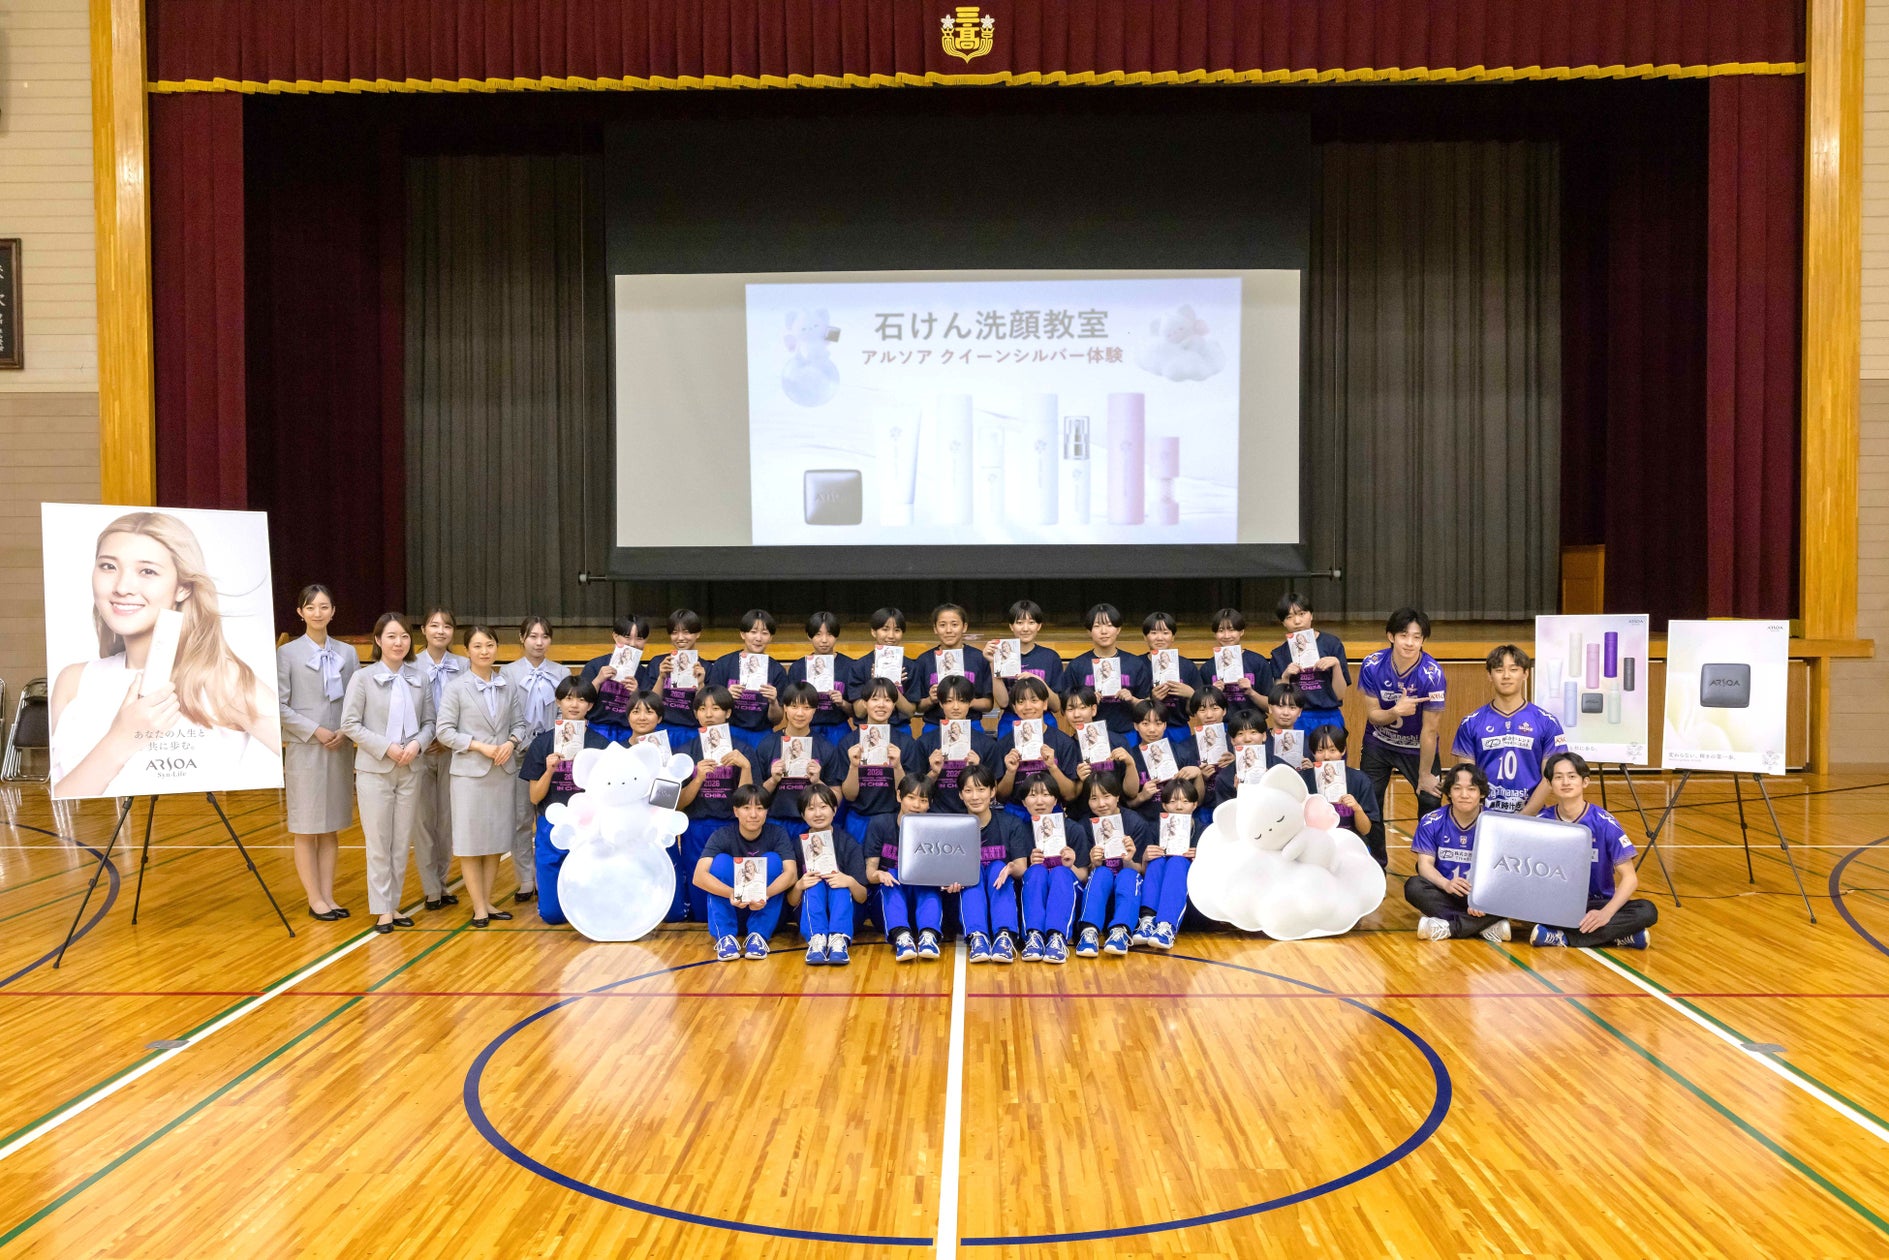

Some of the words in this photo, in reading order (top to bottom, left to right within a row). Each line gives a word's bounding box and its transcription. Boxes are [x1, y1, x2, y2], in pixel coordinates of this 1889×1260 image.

[874, 309, 1109, 341] 石けん洗顔教室
[862, 350, 932, 364] アルソア
[941, 346, 1124, 364] クイーンシルバー体験
[1709, 679, 1741, 687] ARSOA
[134, 729, 205, 739] あなたの人生と
[149, 741, 196, 751] 共に歩む。
[146, 757, 198, 771] ARSOA
[1497, 750, 1517, 780] 10
[914, 842, 966, 856] ARSOA
[1494, 855, 1568, 882] ARSOA
